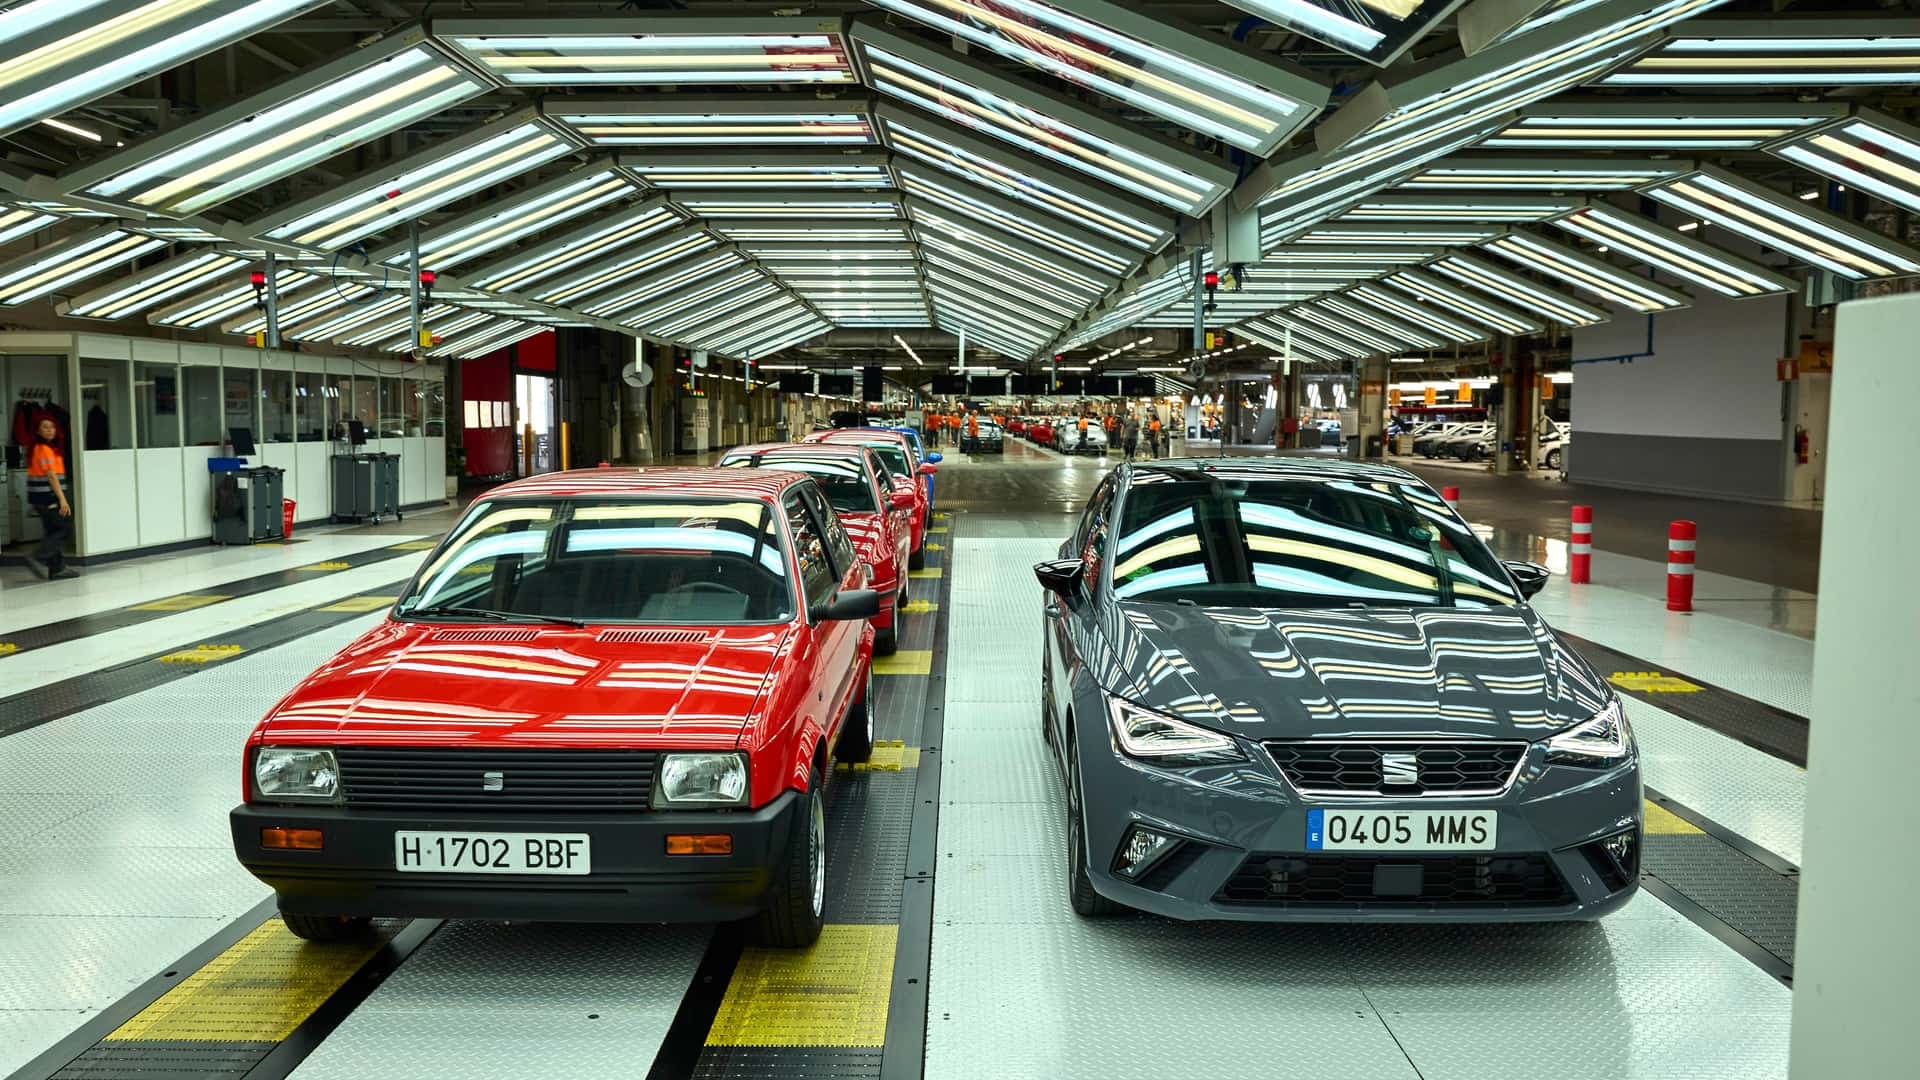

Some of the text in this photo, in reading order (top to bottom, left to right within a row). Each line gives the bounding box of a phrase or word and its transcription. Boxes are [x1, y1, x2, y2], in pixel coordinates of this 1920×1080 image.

[1312, 832, 1319, 841] E
[1328, 815, 1488, 844] 0405 MMS
[525, 839, 584, 868] BBF
